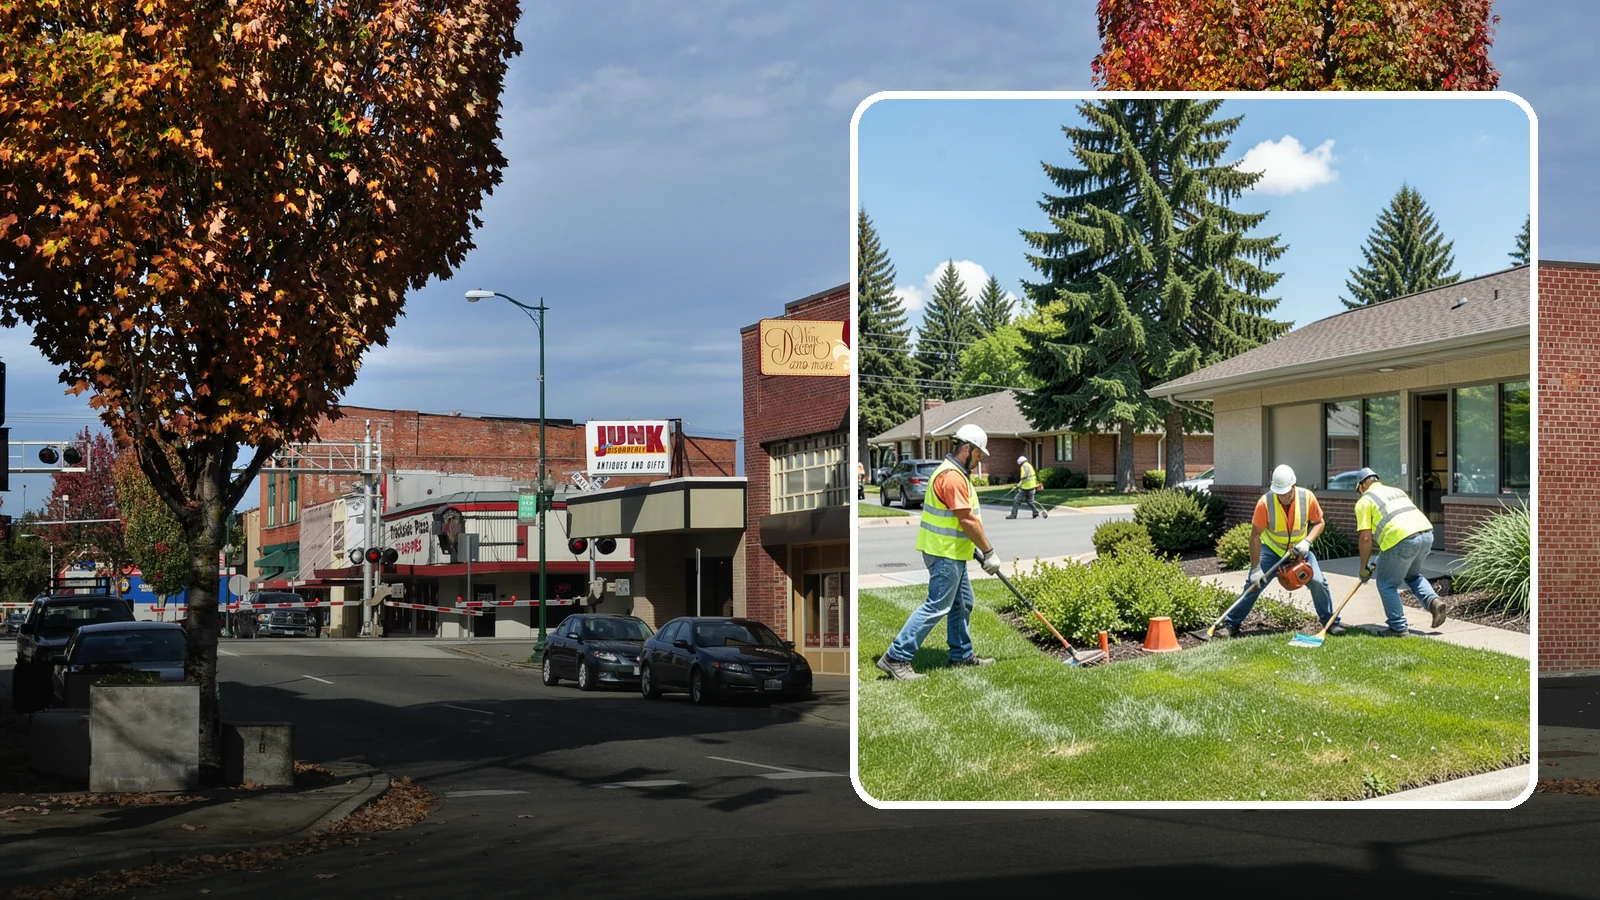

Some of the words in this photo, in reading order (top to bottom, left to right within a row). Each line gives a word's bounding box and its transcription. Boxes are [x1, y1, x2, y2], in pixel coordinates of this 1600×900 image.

[596, 425, 665, 457] JUNK
[607, 446, 647, 454] DISORDERLY
[596, 461, 628, 470] ANTIQUES
[631, 460, 644, 470] AND
[647, 460, 666, 470] GIFTS
[390, 520, 413, 540] Trackside
[414, 519, 429, 535] Pizza
